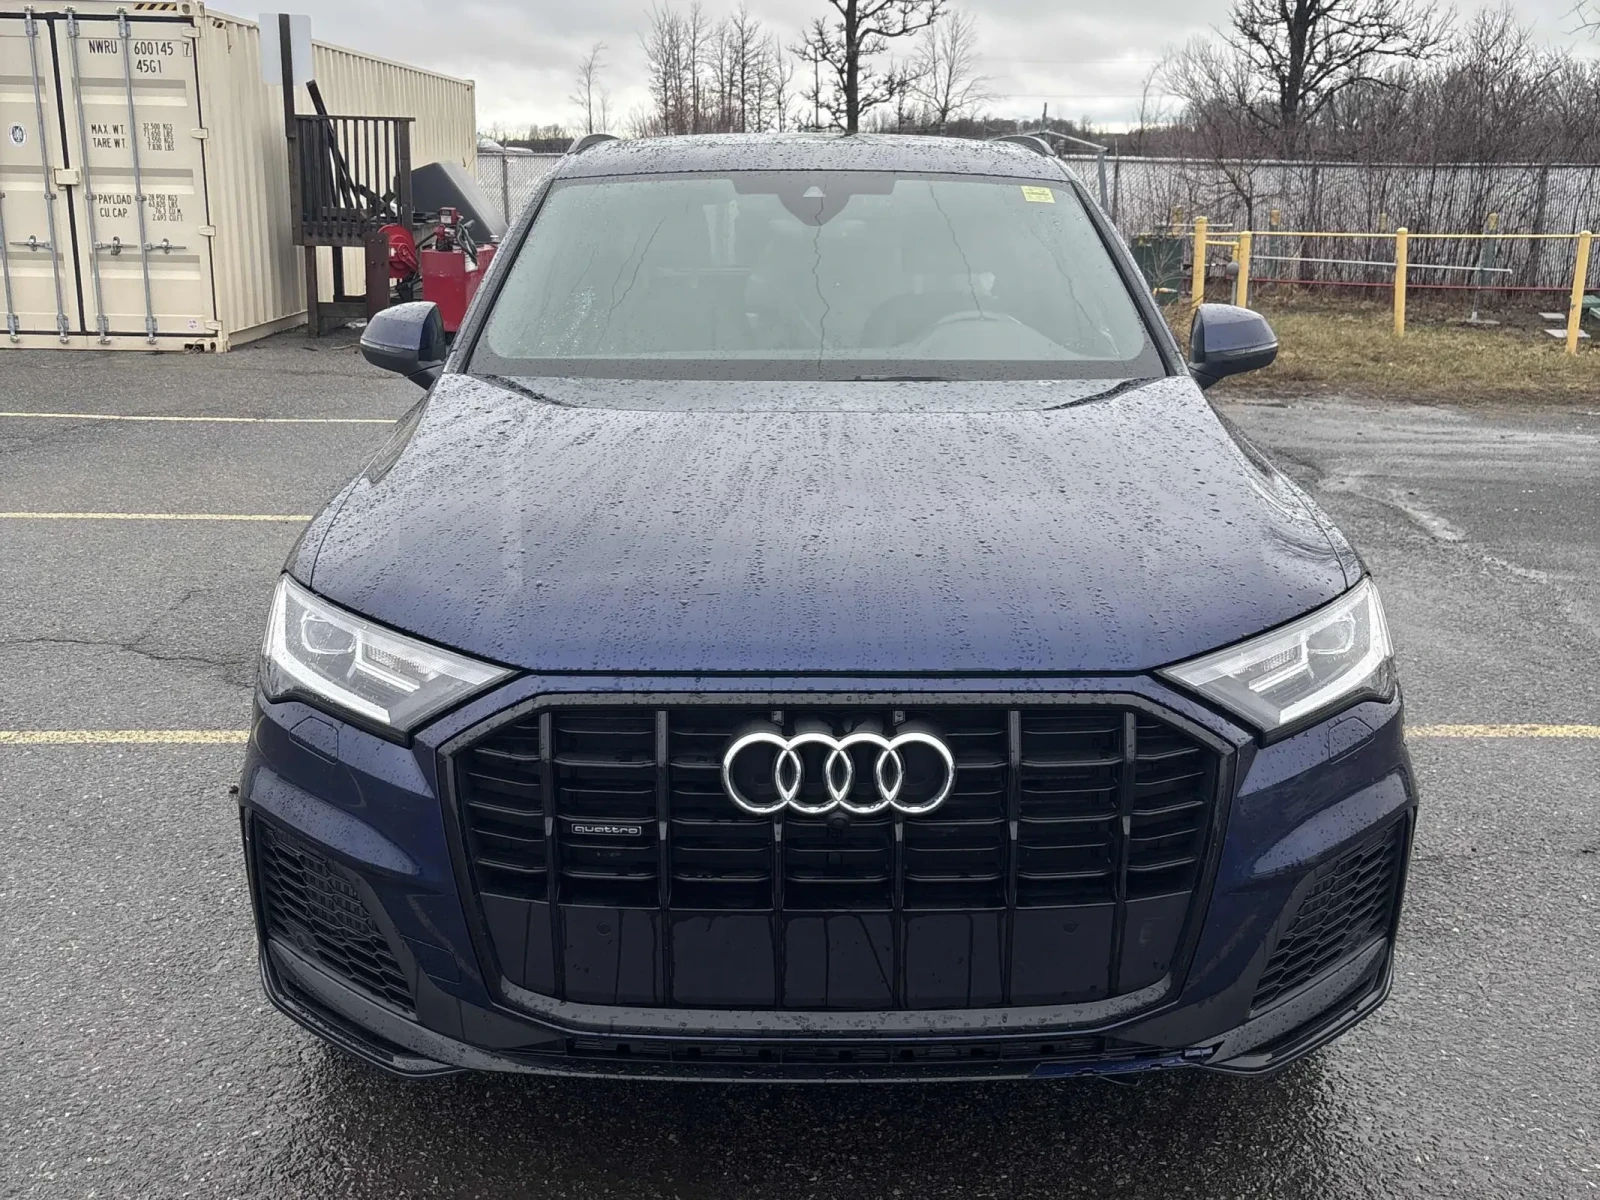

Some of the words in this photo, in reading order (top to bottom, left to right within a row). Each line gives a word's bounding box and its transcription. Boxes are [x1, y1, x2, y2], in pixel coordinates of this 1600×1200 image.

[88, 39, 118, 54] NWRU
[134, 41, 174, 56] 600145
[136, 59, 162, 73] 45G1
[93, 138, 111, 148] TARE
[98, 194, 132, 204] PAYLOAD
[575, 825, 638, 834] quattro
